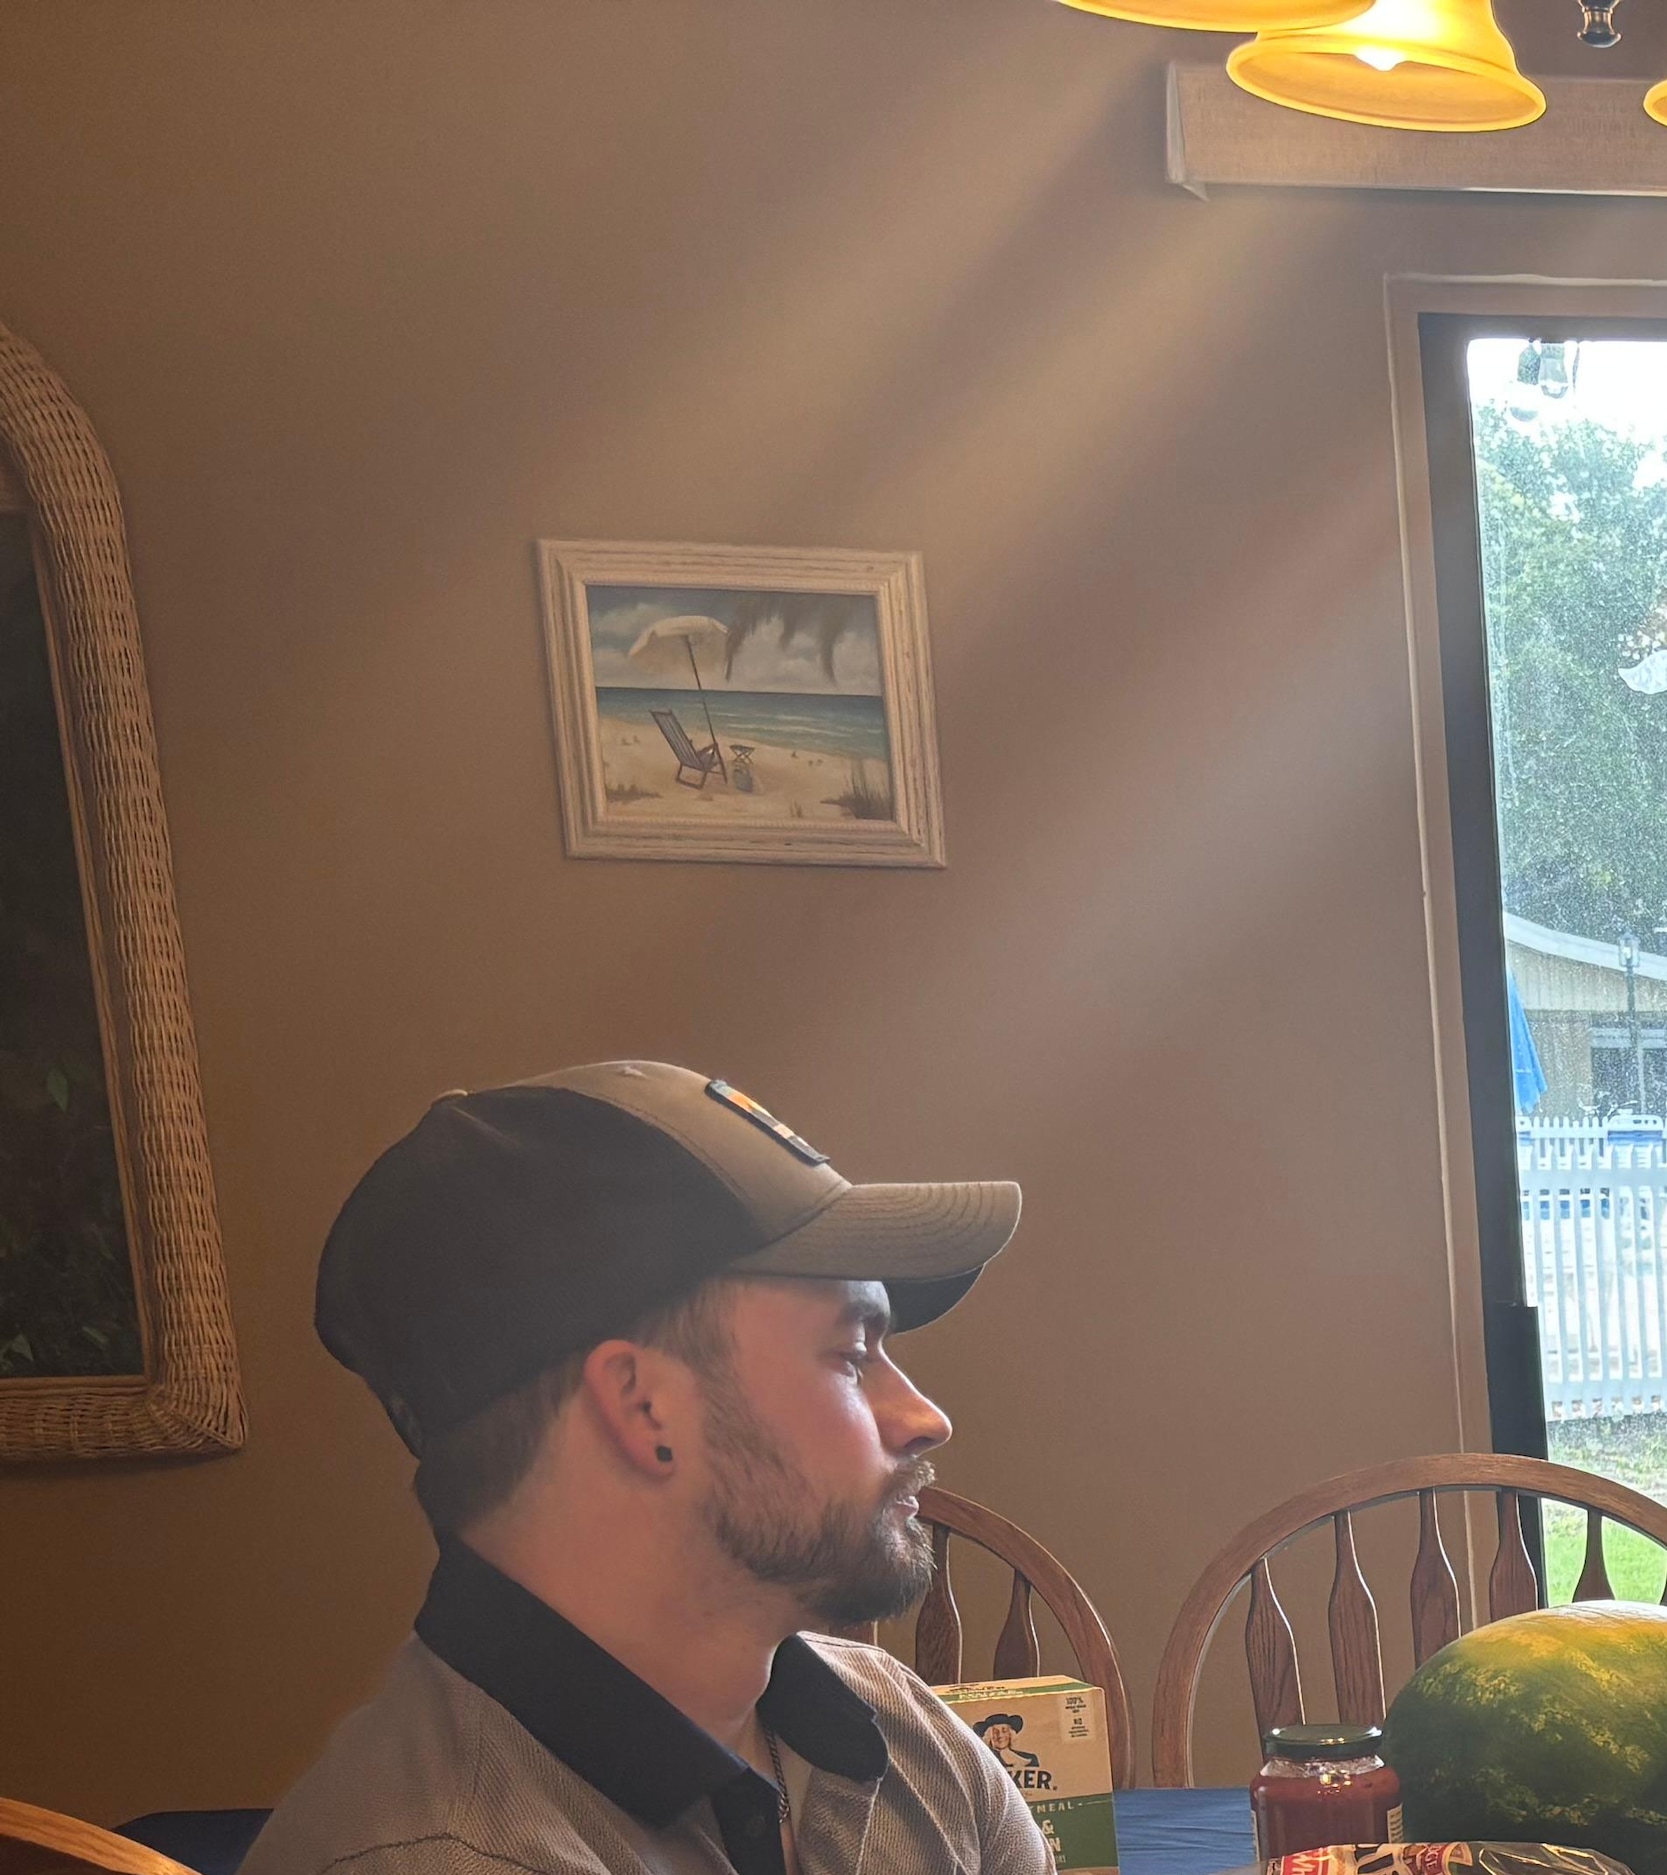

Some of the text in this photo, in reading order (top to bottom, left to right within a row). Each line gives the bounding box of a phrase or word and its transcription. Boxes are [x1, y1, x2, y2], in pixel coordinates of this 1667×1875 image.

[1015, 1770, 1053, 1790] KER
[1036, 1802, 1075, 1814] MEAL
[1042, 1819, 1055, 1835] &
